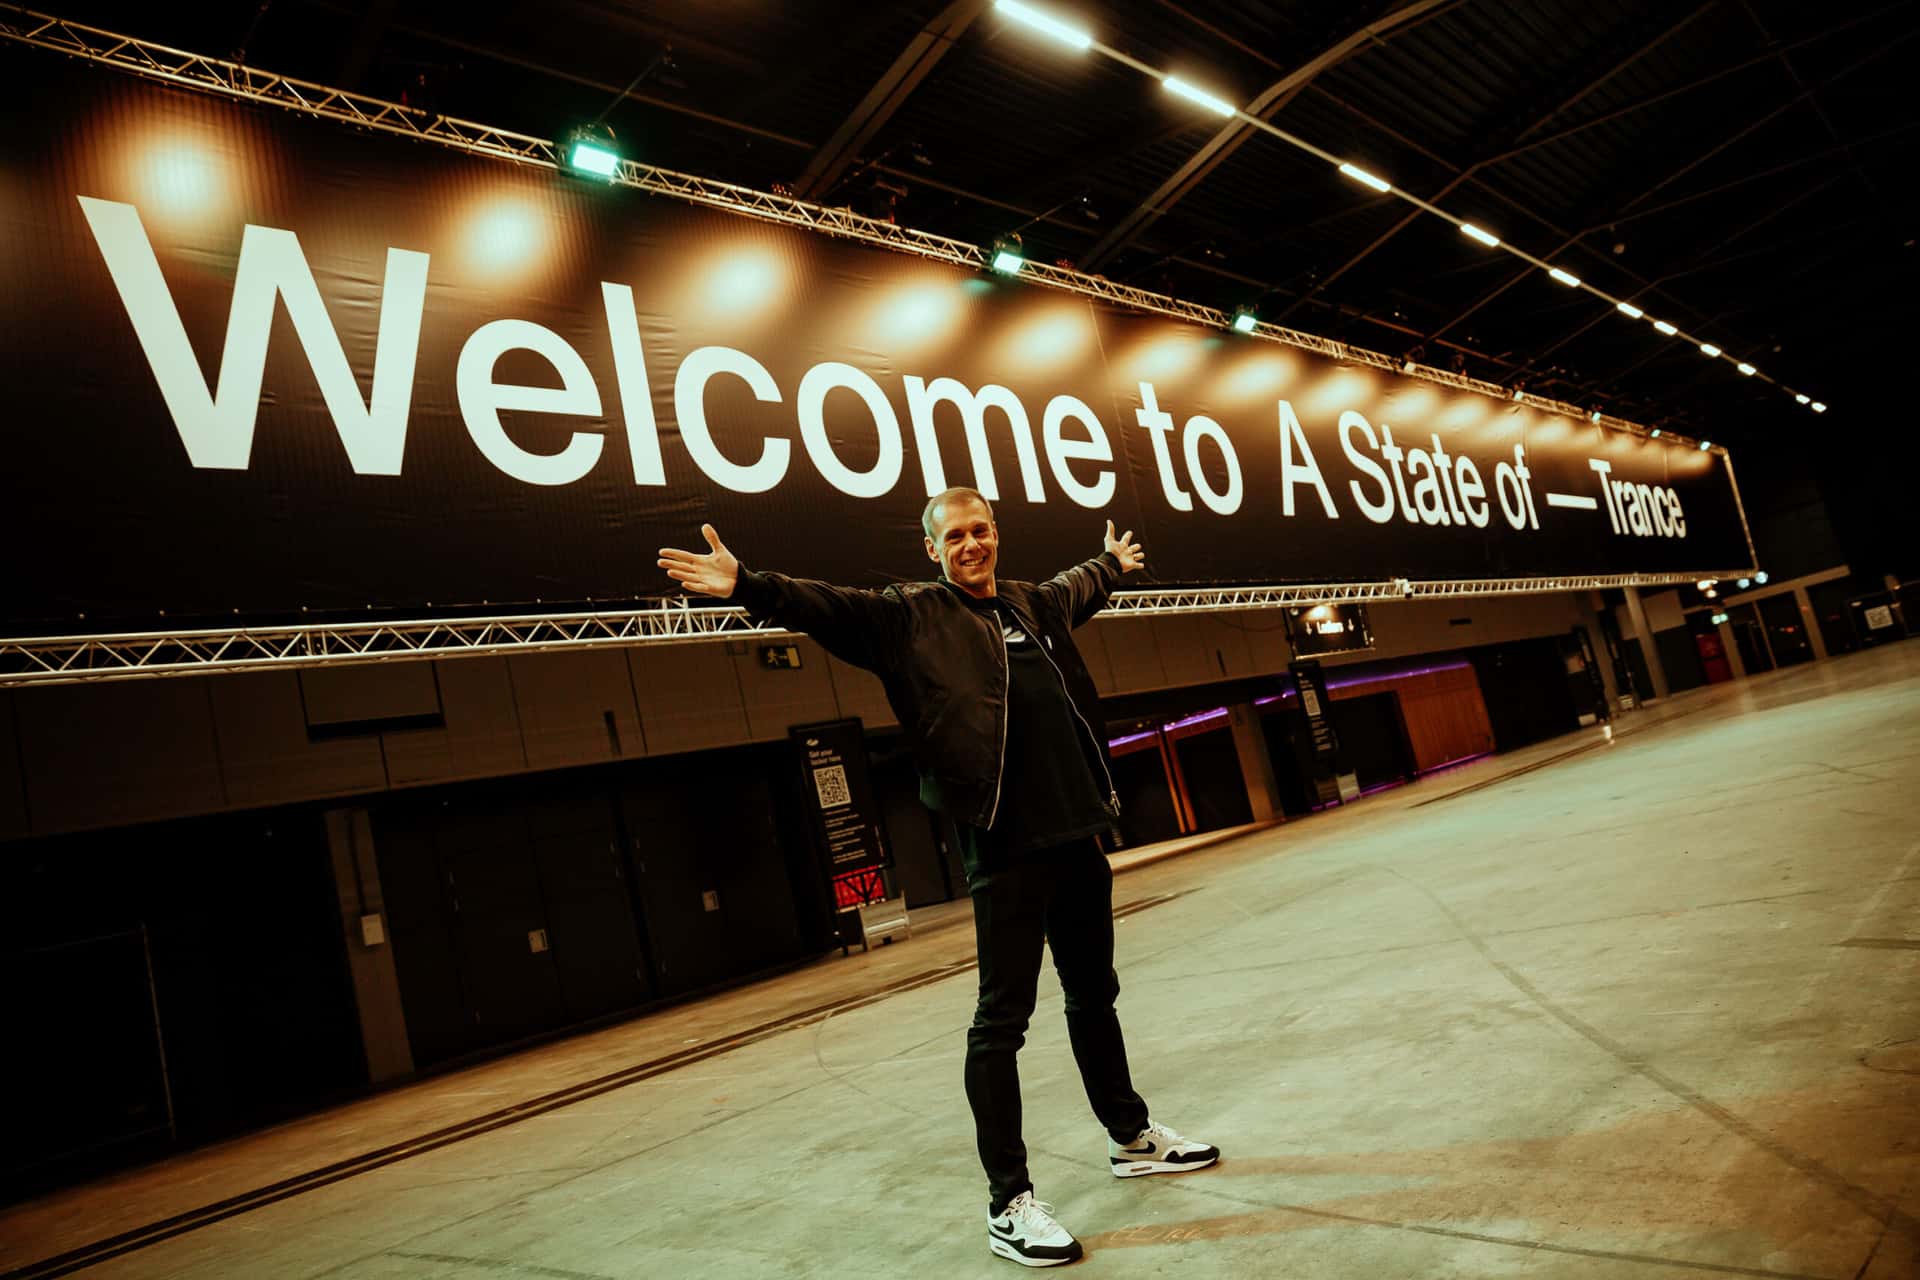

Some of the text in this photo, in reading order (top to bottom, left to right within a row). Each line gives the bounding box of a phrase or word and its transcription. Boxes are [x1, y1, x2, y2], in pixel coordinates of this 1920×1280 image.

[78, 196, 1117, 508] Welcome
[1135, 381, 1244, 516] to
[1278, 399, 1340, 519] A
[1339, 409, 1490, 529] State
[1495, 443, 1540, 531] of
[1588, 457, 1687, 539] Trance
